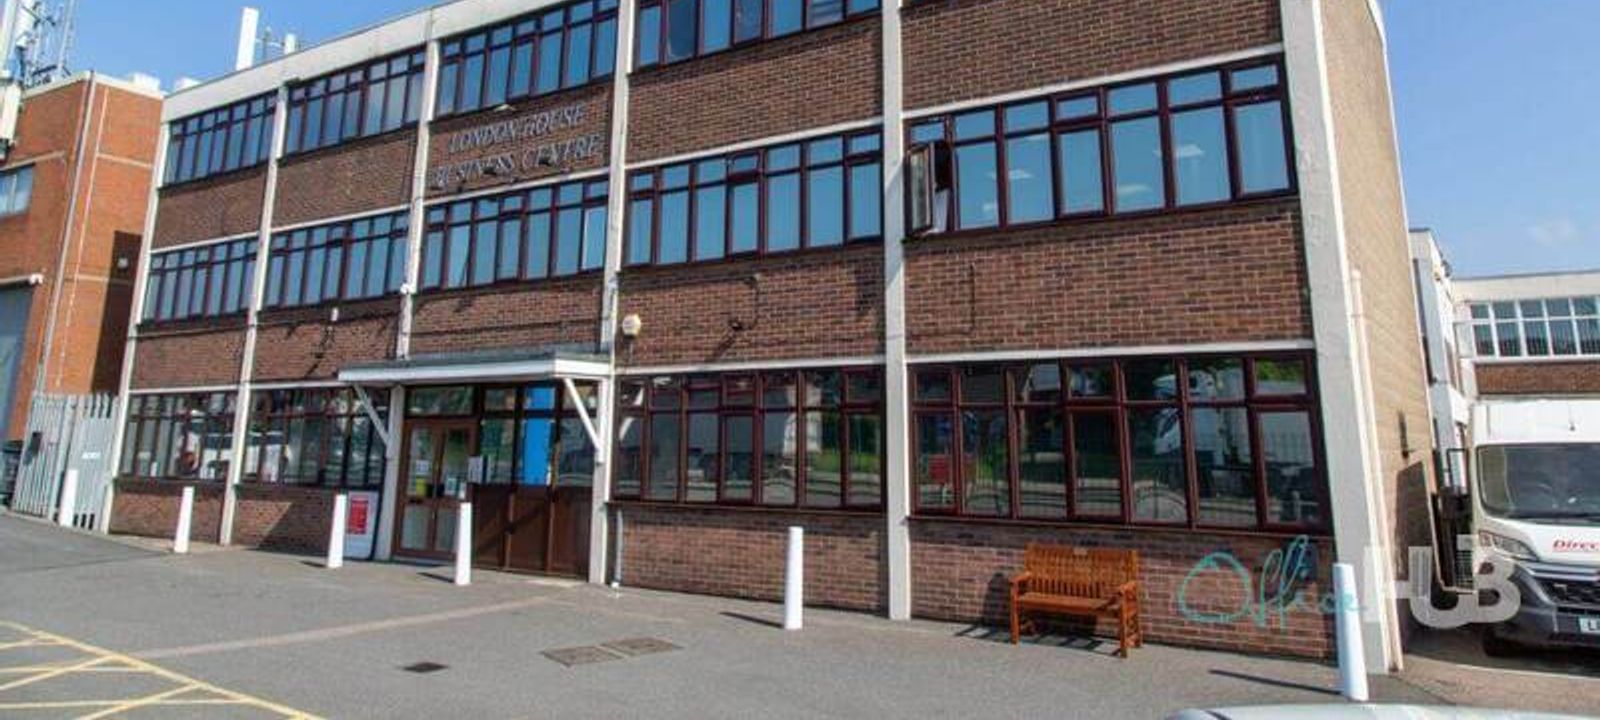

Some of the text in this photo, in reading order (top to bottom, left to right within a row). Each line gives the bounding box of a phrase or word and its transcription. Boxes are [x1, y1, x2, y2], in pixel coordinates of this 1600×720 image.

[449, 104, 587, 153] LONDON HOUSE
[430, 133, 603, 190] BUSINESS CENTRE
